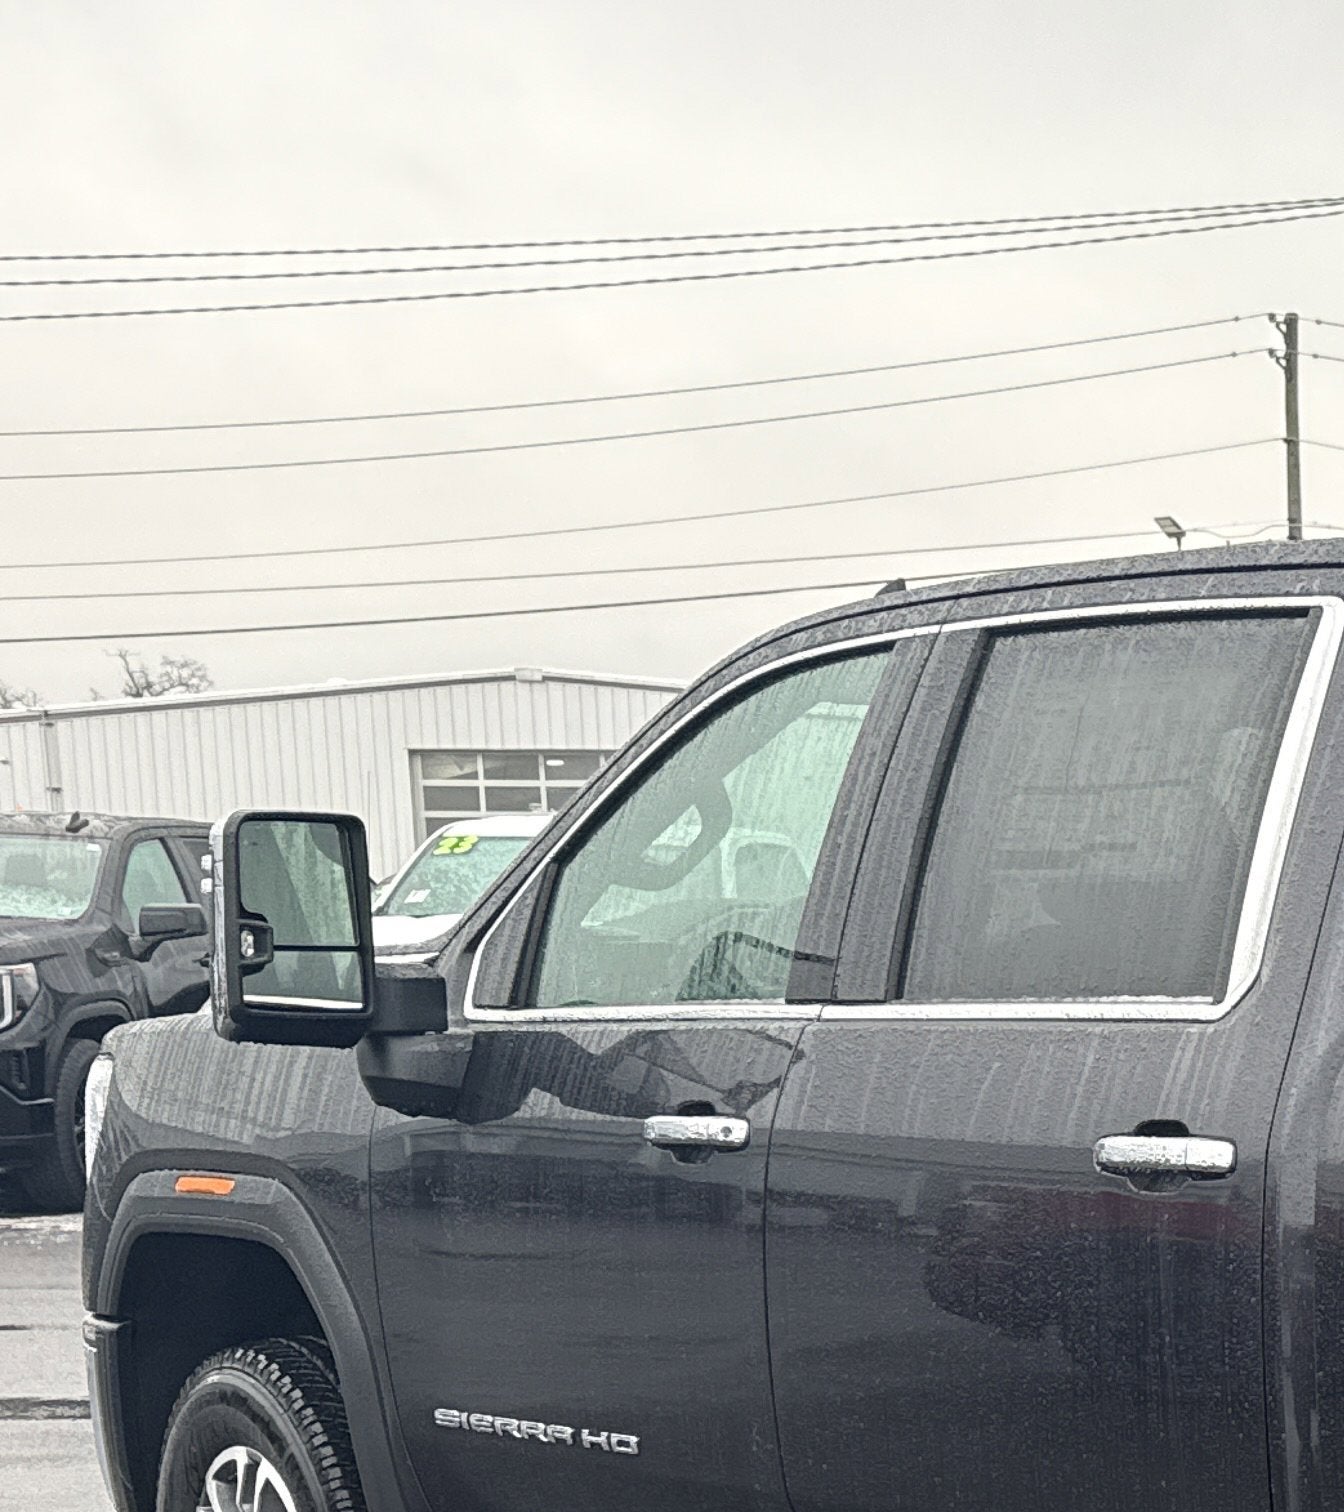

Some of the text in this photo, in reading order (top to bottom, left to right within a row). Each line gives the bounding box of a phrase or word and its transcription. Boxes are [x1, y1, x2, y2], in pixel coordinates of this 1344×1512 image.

[433, 835, 480, 855] 23
[433, 1407, 641, 1456] SIERRA HD
